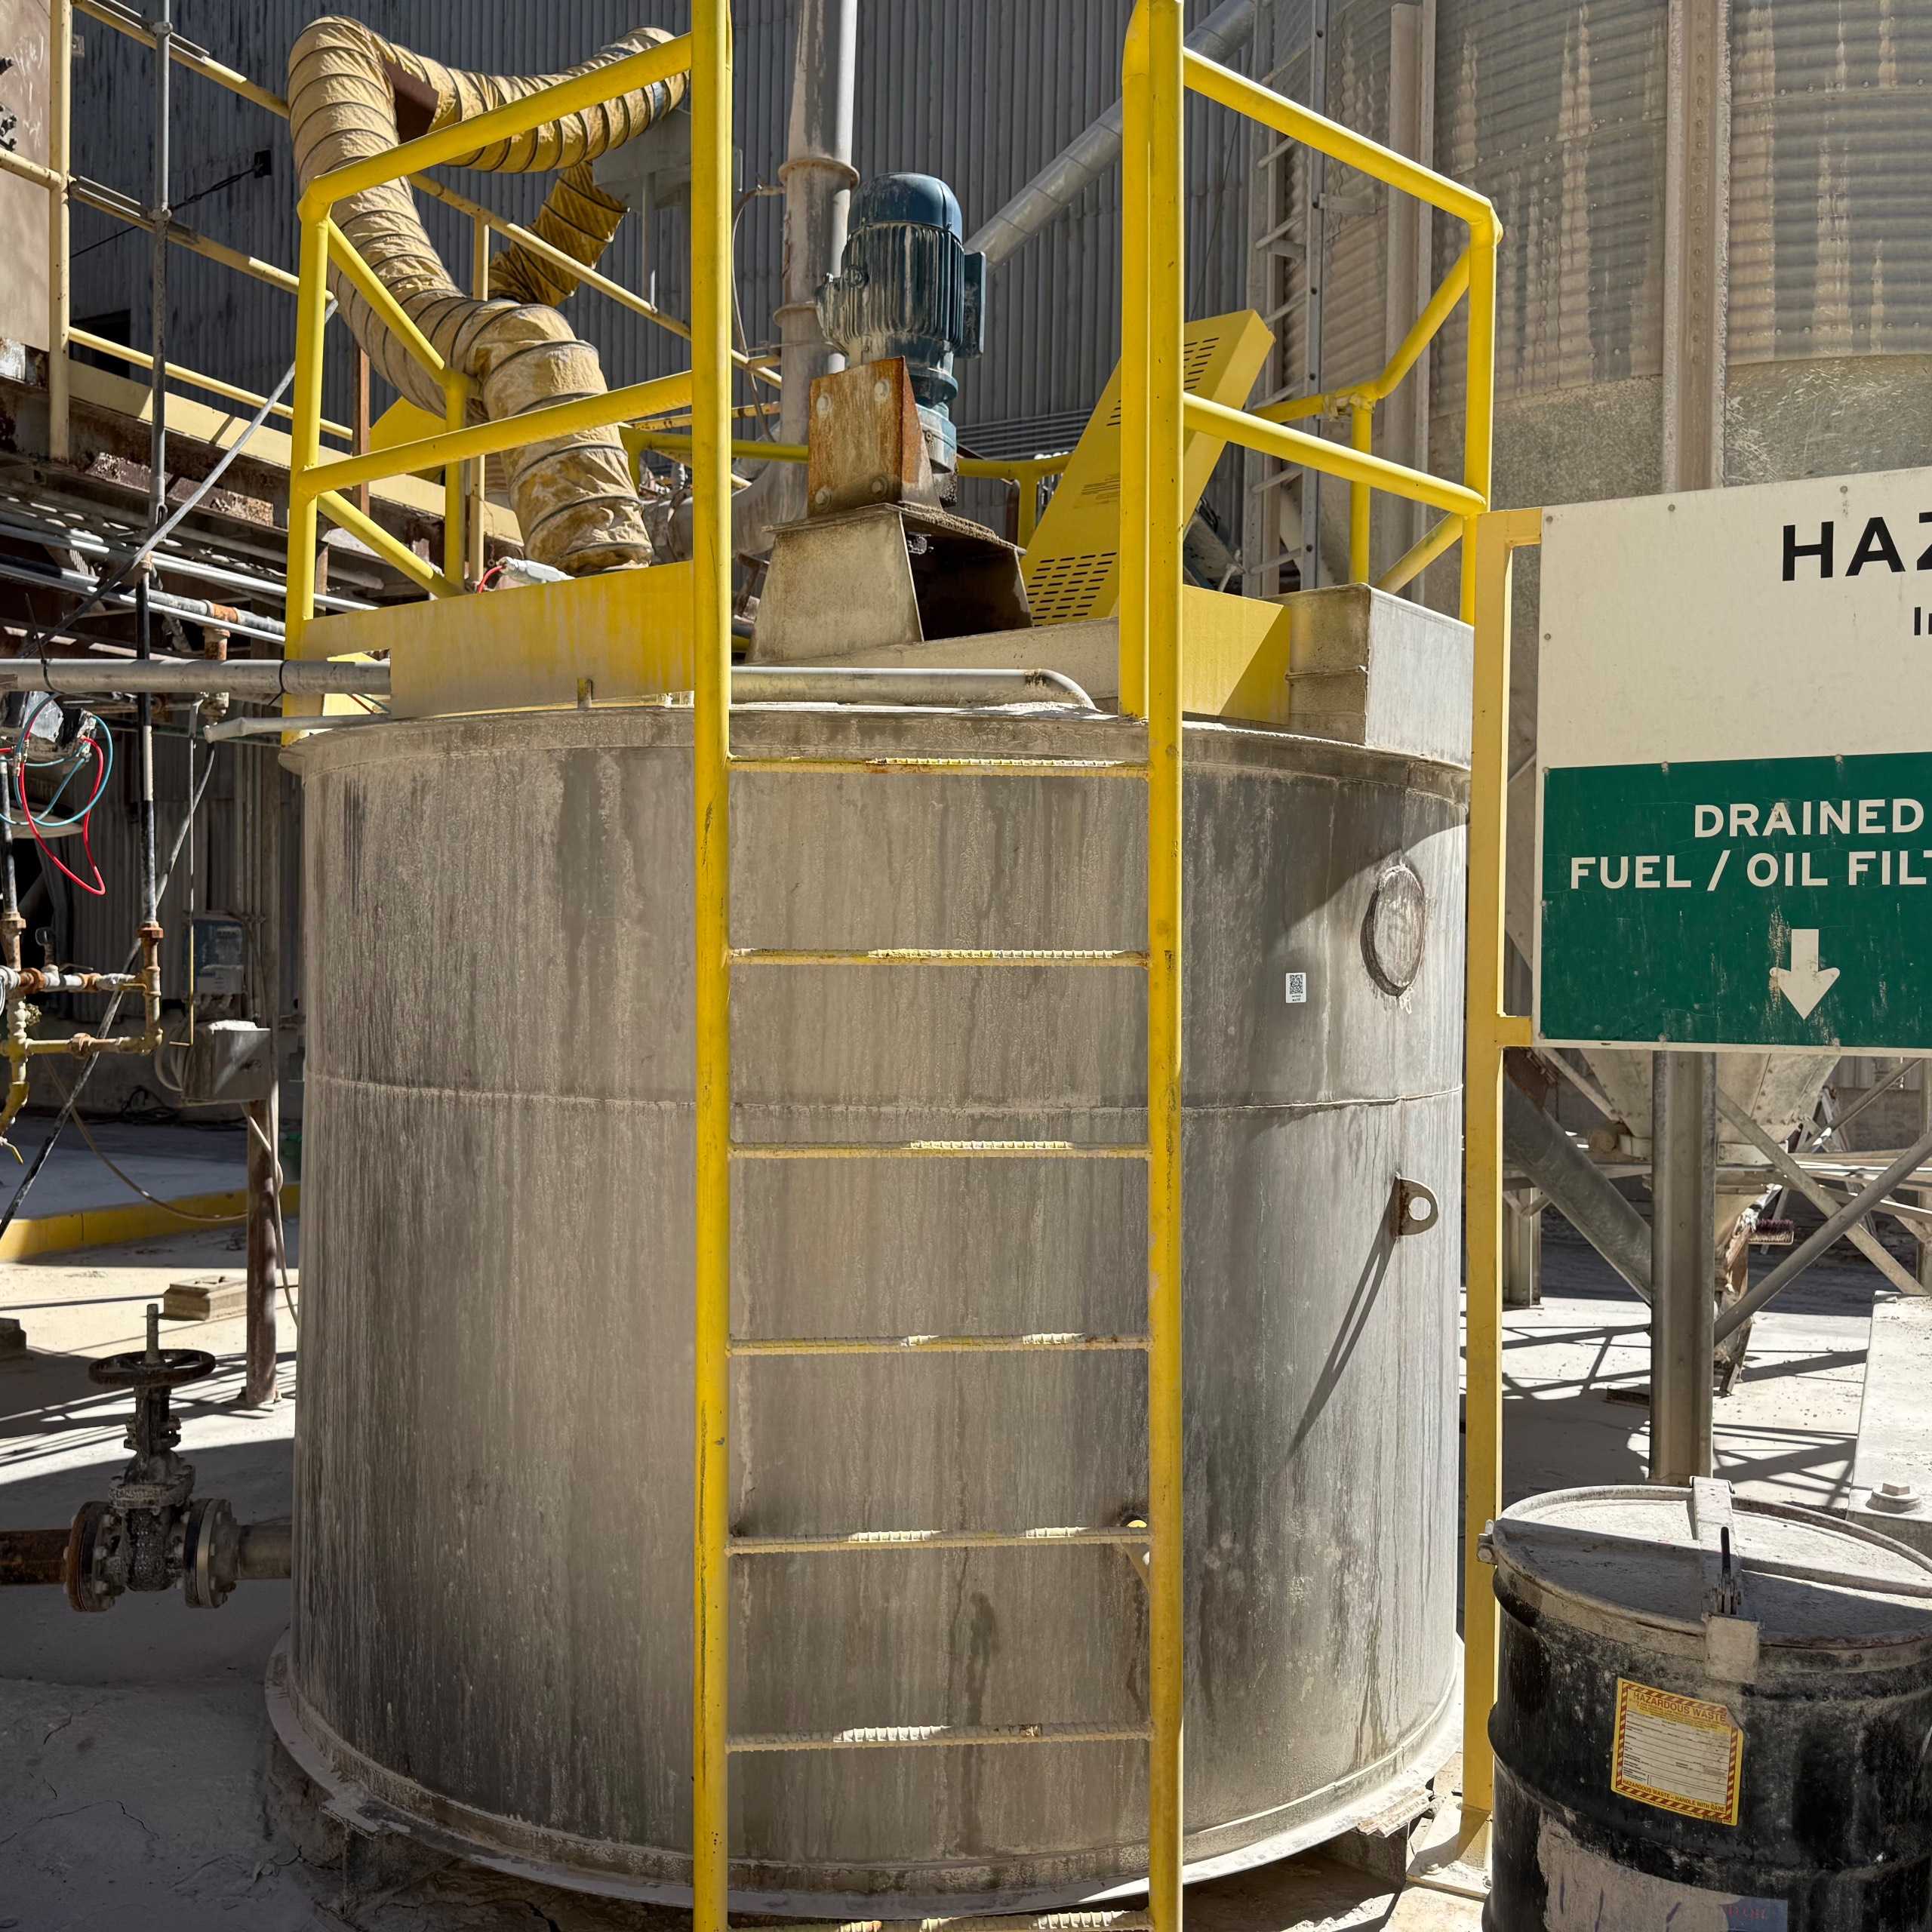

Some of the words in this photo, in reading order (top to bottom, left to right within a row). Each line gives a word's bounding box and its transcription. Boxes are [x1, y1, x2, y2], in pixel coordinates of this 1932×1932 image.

[1694, 798, 1924, 838] DRAINED
[1571, 855, 1692, 889] FUEL
[1706, 850, 1730, 891] /
[1746, 852, 1828, 887] OIL
[1848, 850, 1932, 885] FIL
[1633, 1692, 1690, 1714] HAZARDOUS
[1693, 1708, 1726, 1722] WASTE
[1653, 1789, 1669, 1799] WASTE
